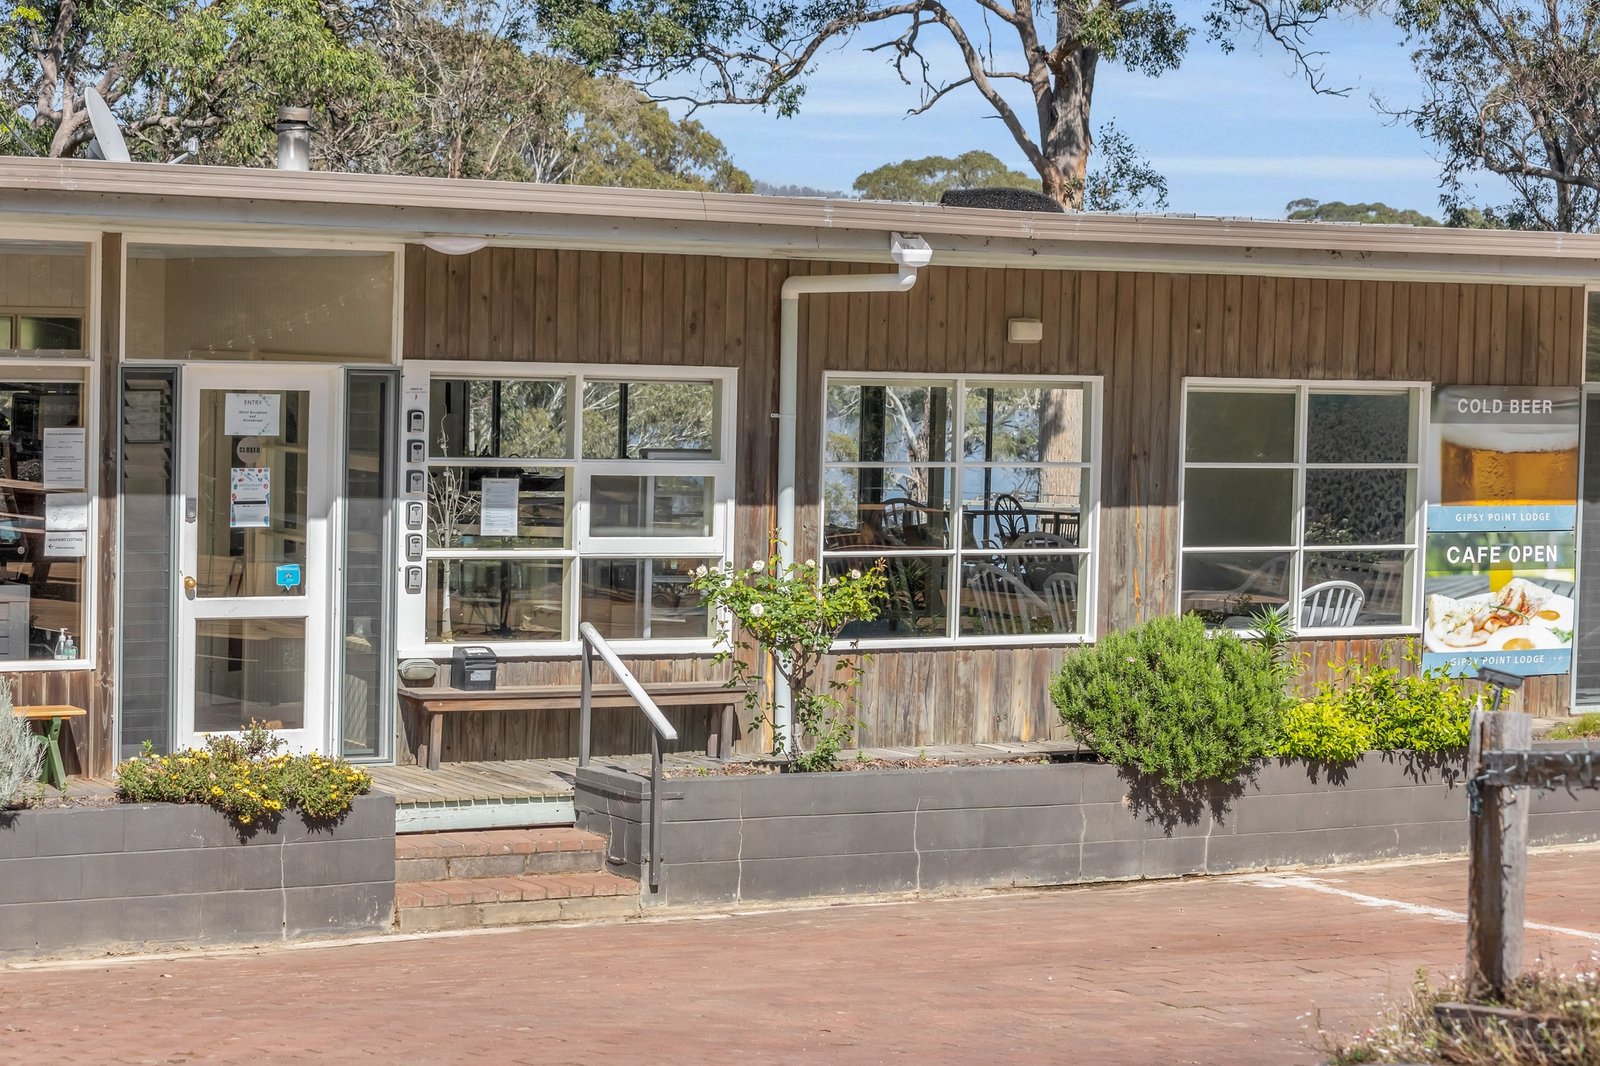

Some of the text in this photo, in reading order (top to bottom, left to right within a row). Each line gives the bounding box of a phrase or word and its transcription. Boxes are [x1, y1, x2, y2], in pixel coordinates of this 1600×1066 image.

[1457, 398, 1553, 414] COLD BEER
[1520, 512, 1550, 521] LODGE
[1446, 545, 1557, 564] CAFE OPEN
[1514, 654, 1545, 664] LODGE
